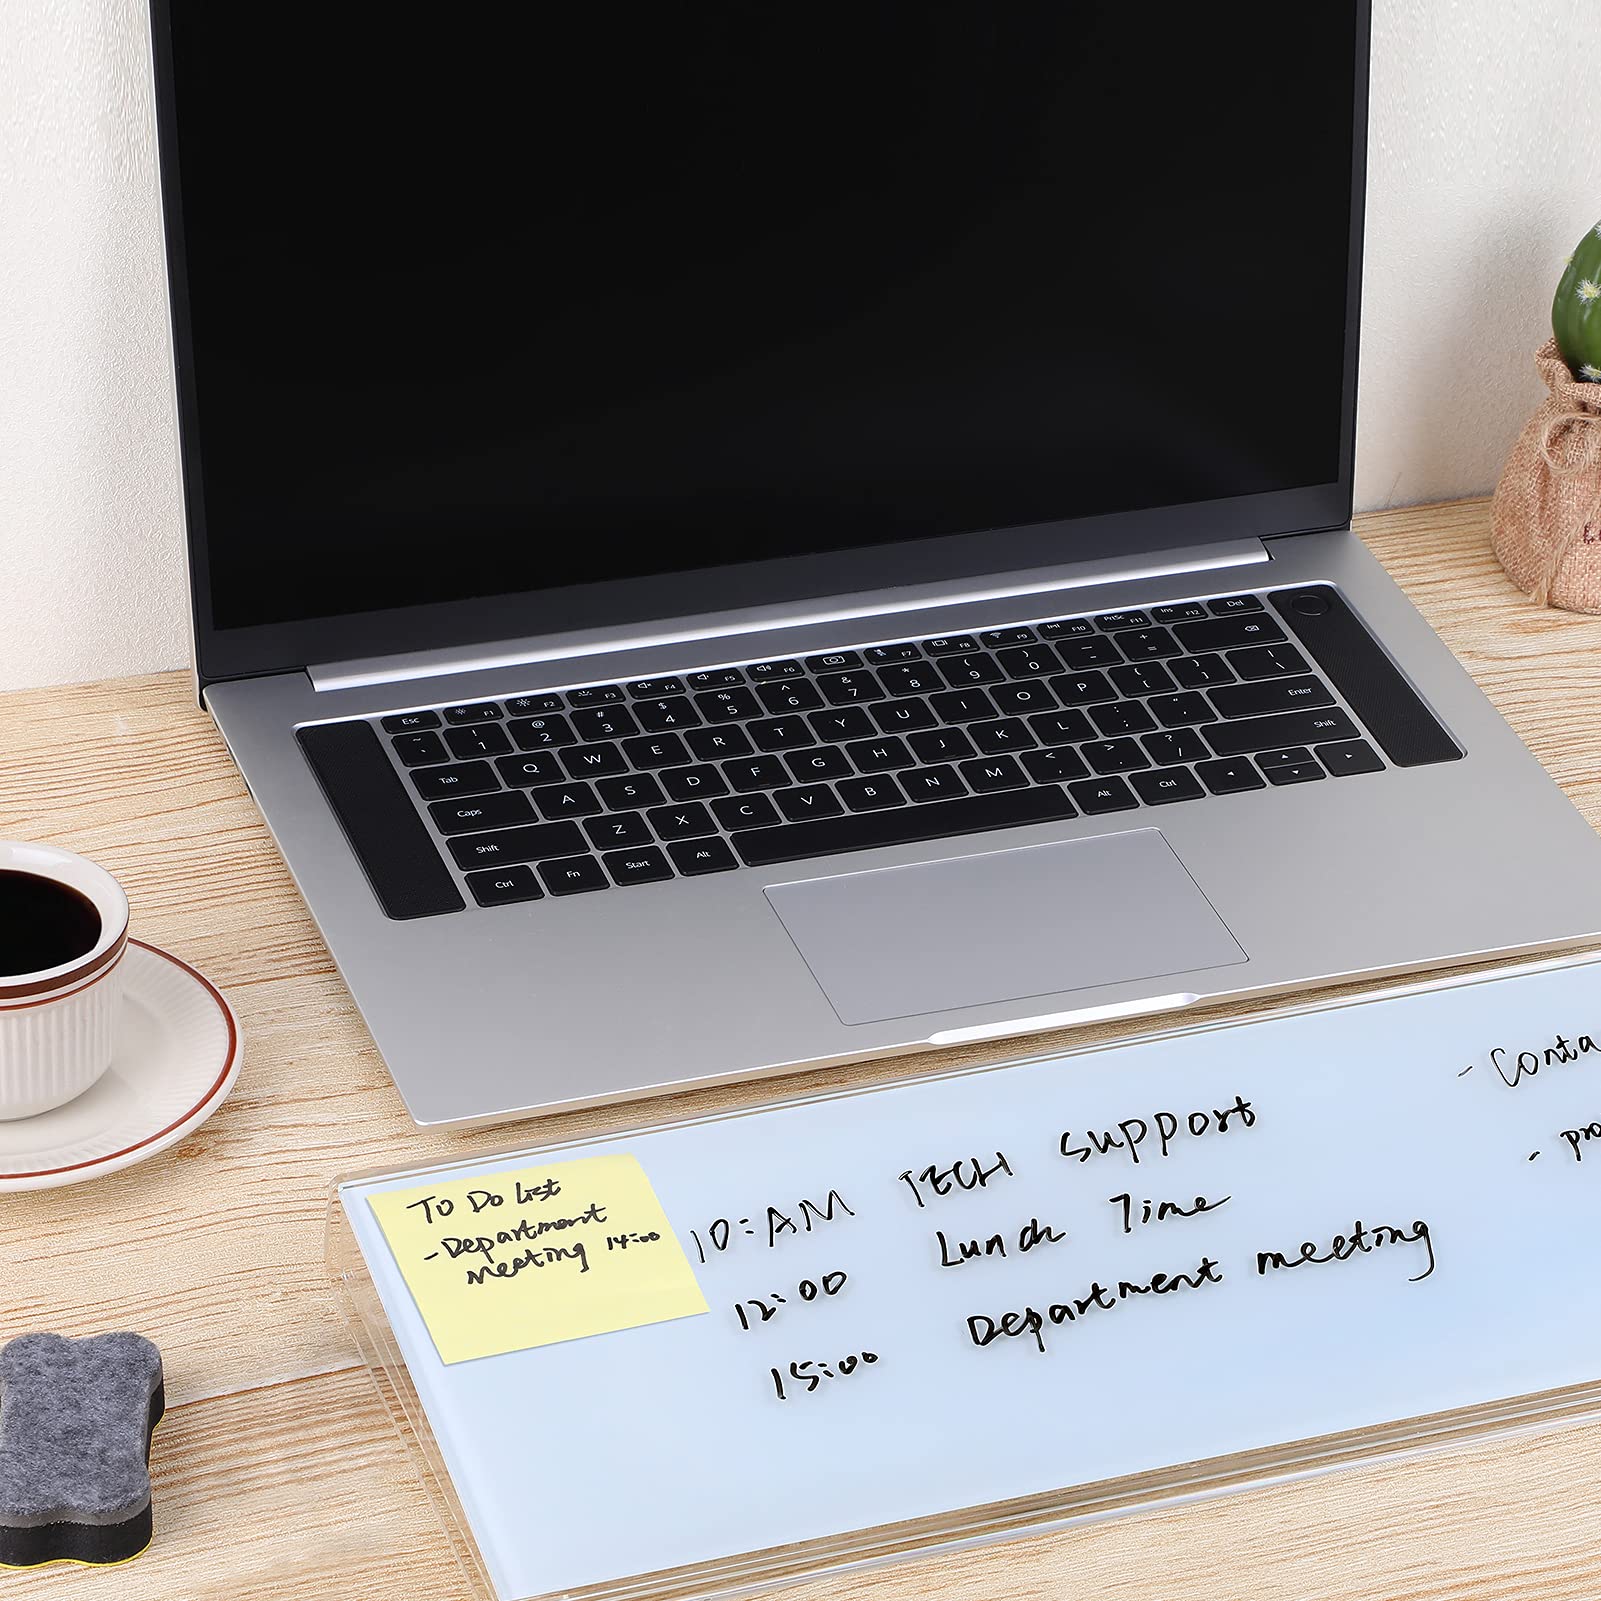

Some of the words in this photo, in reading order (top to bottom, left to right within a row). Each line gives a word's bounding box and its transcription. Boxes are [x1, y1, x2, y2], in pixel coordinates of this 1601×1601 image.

[1226, 599, 1245, 607] Del
[1028, 661, 1040, 670] 0
[841, 676, 852, 684] &
[969, 670, 981, 680] 9
[909, 679, 921, 688] 8
[1076, 682, 1087, 692] P
[847, 688, 857, 697] 7
[1016, 691, 1031, 701] O
[1287, 687, 1312, 696] Enter
[717, 693, 731, 701] %
[788, 696, 800, 706] 6
[657, 702, 667, 710] $
[726, 705, 738, 715] 5
[960, 700, 967, 710] I
[665, 714, 676, 723] 4
[895, 709, 910, 719] U
[402, 716, 420, 725] Esc
[531, 720, 545, 729] @
[834, 718, 846, 728] Y
[1056, 721, 1069, 730] L
[1313, 719, 1337, 728] Shift
[471, 729, 478, 737] !
[601, 723, 614, 733] 3
[773, 727, 784, 737] T
[539, 732, 553, 742] 2
[995, 729, 1009, 739] K
[1164, 734, 1173, 742] ?
[478, 741, 487, 750] 1
[712, 736, 726, 747] R
[939, 739, 946, 749] J
[650, 745, 663, 755] E
[872, 748, 888, 758] H
[583, 754, 601, 765] W
[811, 757, 826, 768] G
[522, 763, 540, 773] Q
[750, 766, 761, 777] F
[984, 767, 1003, 778] M
[438, 776, 459, 784] Tab
[686, 776, 701, 786] D
[924, 776, 941, 787] N
[1158, 779, 1178, 788] Ctrl
[624, 785, 636, 796] S
[864, 786, 877, 797] B
[1097, 789, 1112, 798] Alt
[562, 794, 576, 805] A
[800, 795, 813, 805] V
[456, 809, 483, 818] Caps
[739, 805, 754, 815] C
[674, 815, 690, 826] X
[612, 824, 627, 835] Z
[475, 844, 500, 854] Shift
[696, 851, 711, 859] Alt
[625, 860, 651, 870] Start
[566, 870, 581, 878] Fn
[494, 879, 515, 889] Ctrl
[466, 1190, 504, 1213] Do
[734, 1271, 848, 1331] 12:00
[935, 1218, 1067, 1267] Lunch
[1108, 1193, 1232, 1234] Time
[770, 1351, 879, 1400] 15:00
[966, 1257, 1223, 1353] Department
[1256, 1220, 1435, 1282] meeting
